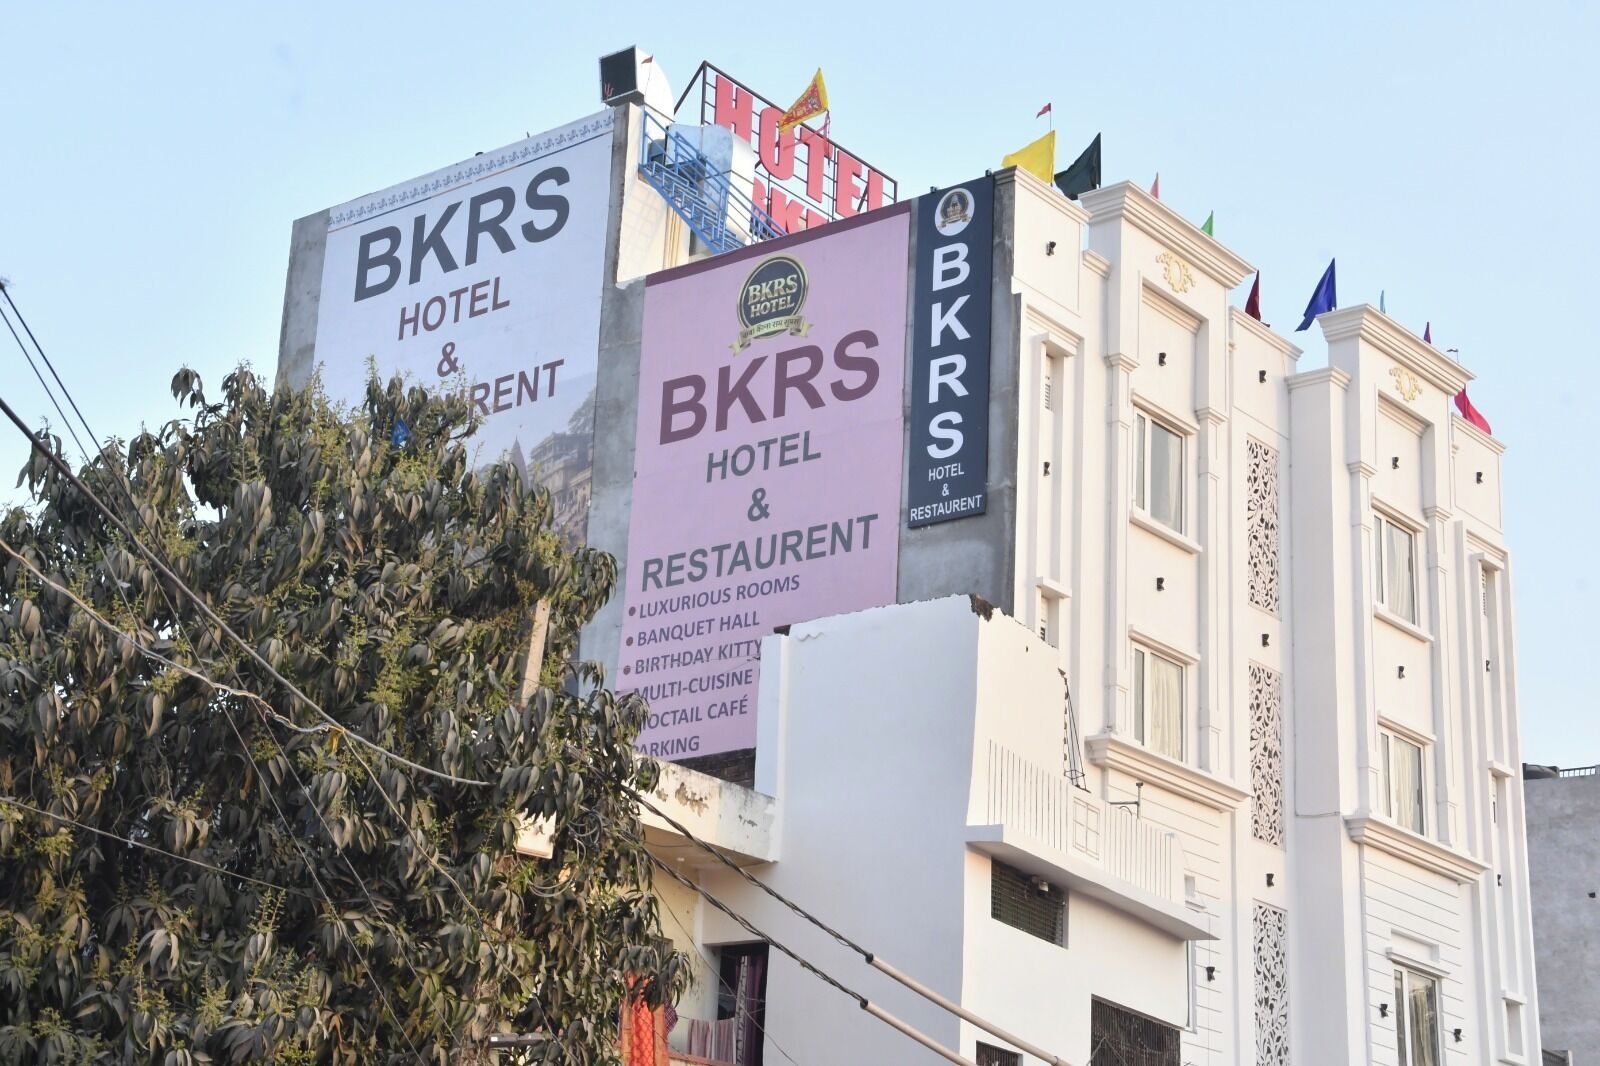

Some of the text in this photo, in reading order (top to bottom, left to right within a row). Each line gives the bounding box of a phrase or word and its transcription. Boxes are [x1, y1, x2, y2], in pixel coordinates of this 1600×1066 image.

[354, 166, 570, 302] BKRS
[748, 274, 798, 305] BKRS
[750, 295, 795, 318] HOTEL
[398, 276, 510, 341] HOTEL
[437, 342, 459, 377] &
[927, 242, 971, 459] BKRS
[659, 329, 880, 445] BKRS
[706, 430, 822, 483] HOTEL
[928, 462, 964, 482] HOTEL
[747, 487, 770, 522] &
[910, 494, 983, 522] RESTAURENT
[941, 483, 950, 497] &
[641, 513, 879, 592] RESTAURENT
[639, 574, 800, 619] LUXURIOUS ROOMS
[637, 610, 760, 647] BANQUET HALL
[634, 639, 762, 675] BIRTHDAY KITTY
[641, 693, 749, 730] OCTAIL CAFÉ
